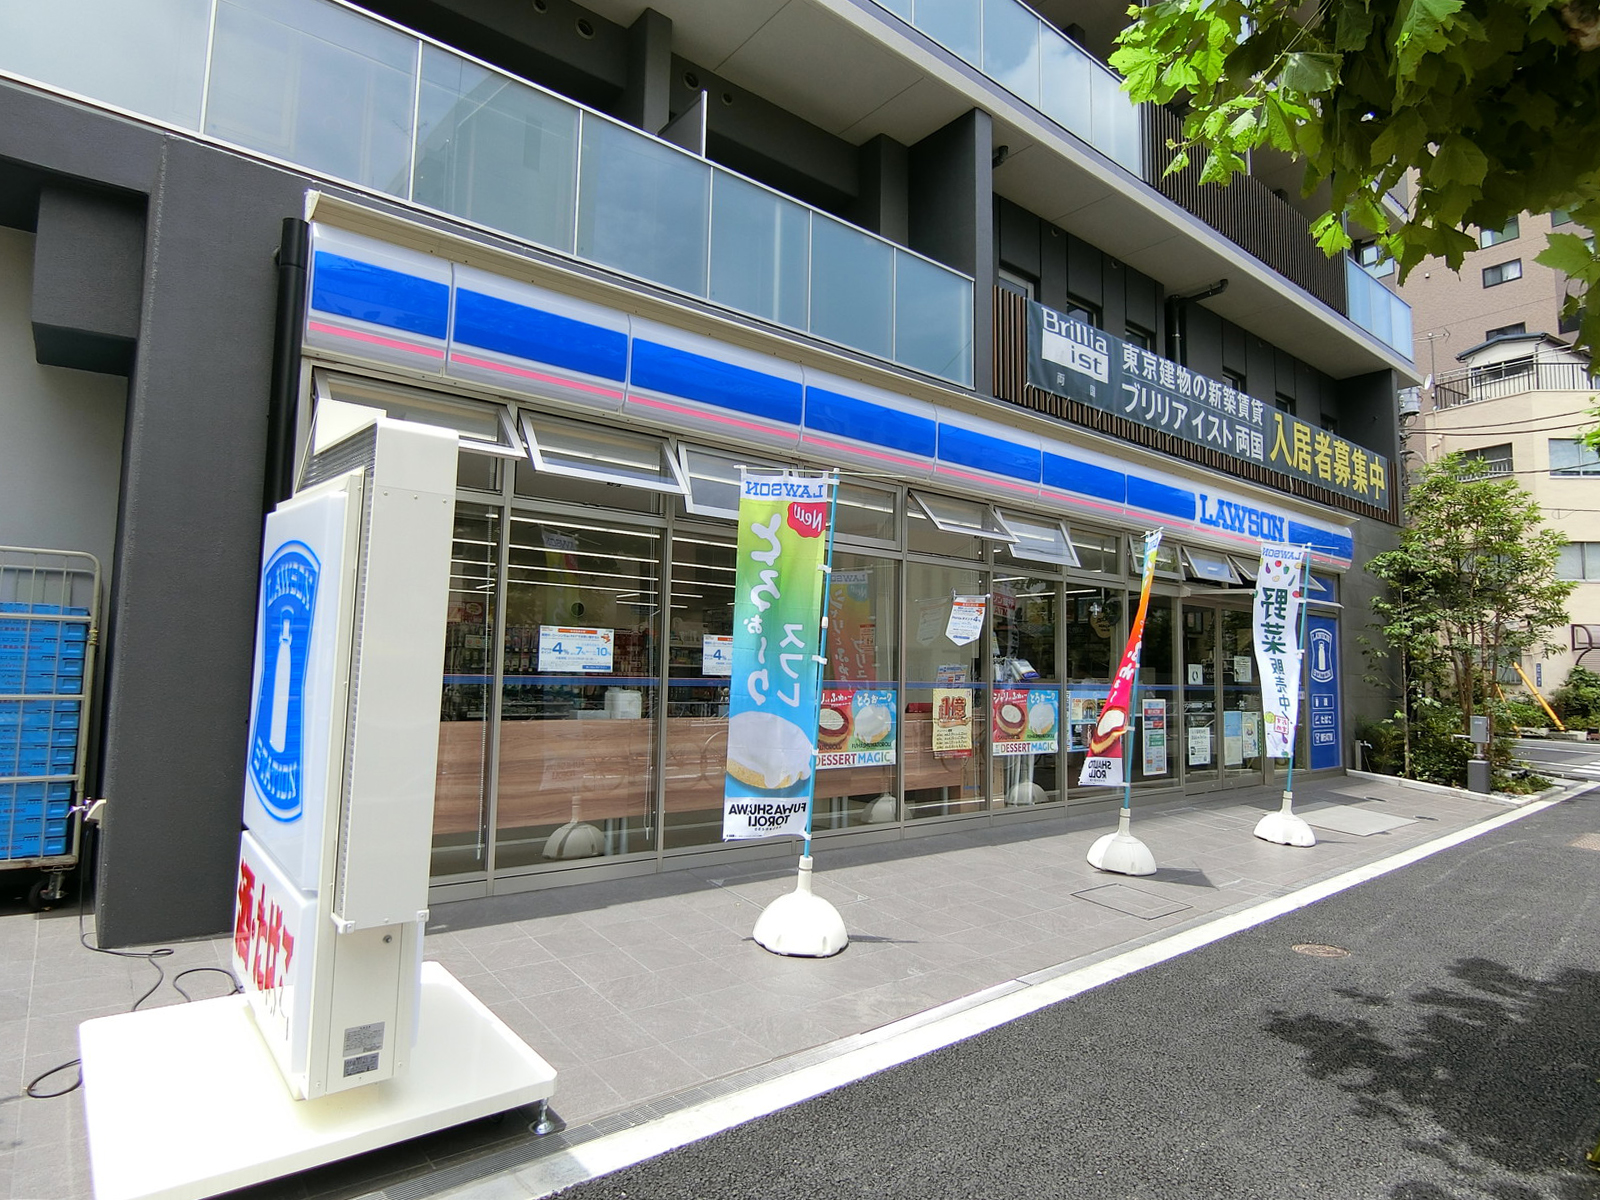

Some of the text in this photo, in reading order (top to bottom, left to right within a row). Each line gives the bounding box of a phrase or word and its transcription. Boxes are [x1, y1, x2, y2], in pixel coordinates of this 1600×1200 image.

[1041, 307, 1108, 355] Brillia
[1070, 345, 1102, 375] ist
[1122, 343, 1263, 426] 東京建物の新築賃貸
[1270, 413, 1386, 500] 入居者募集中
[1199, 494, 1285, 542] LAWSON
[857, 751, 891, 764] MAGIC
[1000, 742, 1055, 753] DESSERT MAGIC
